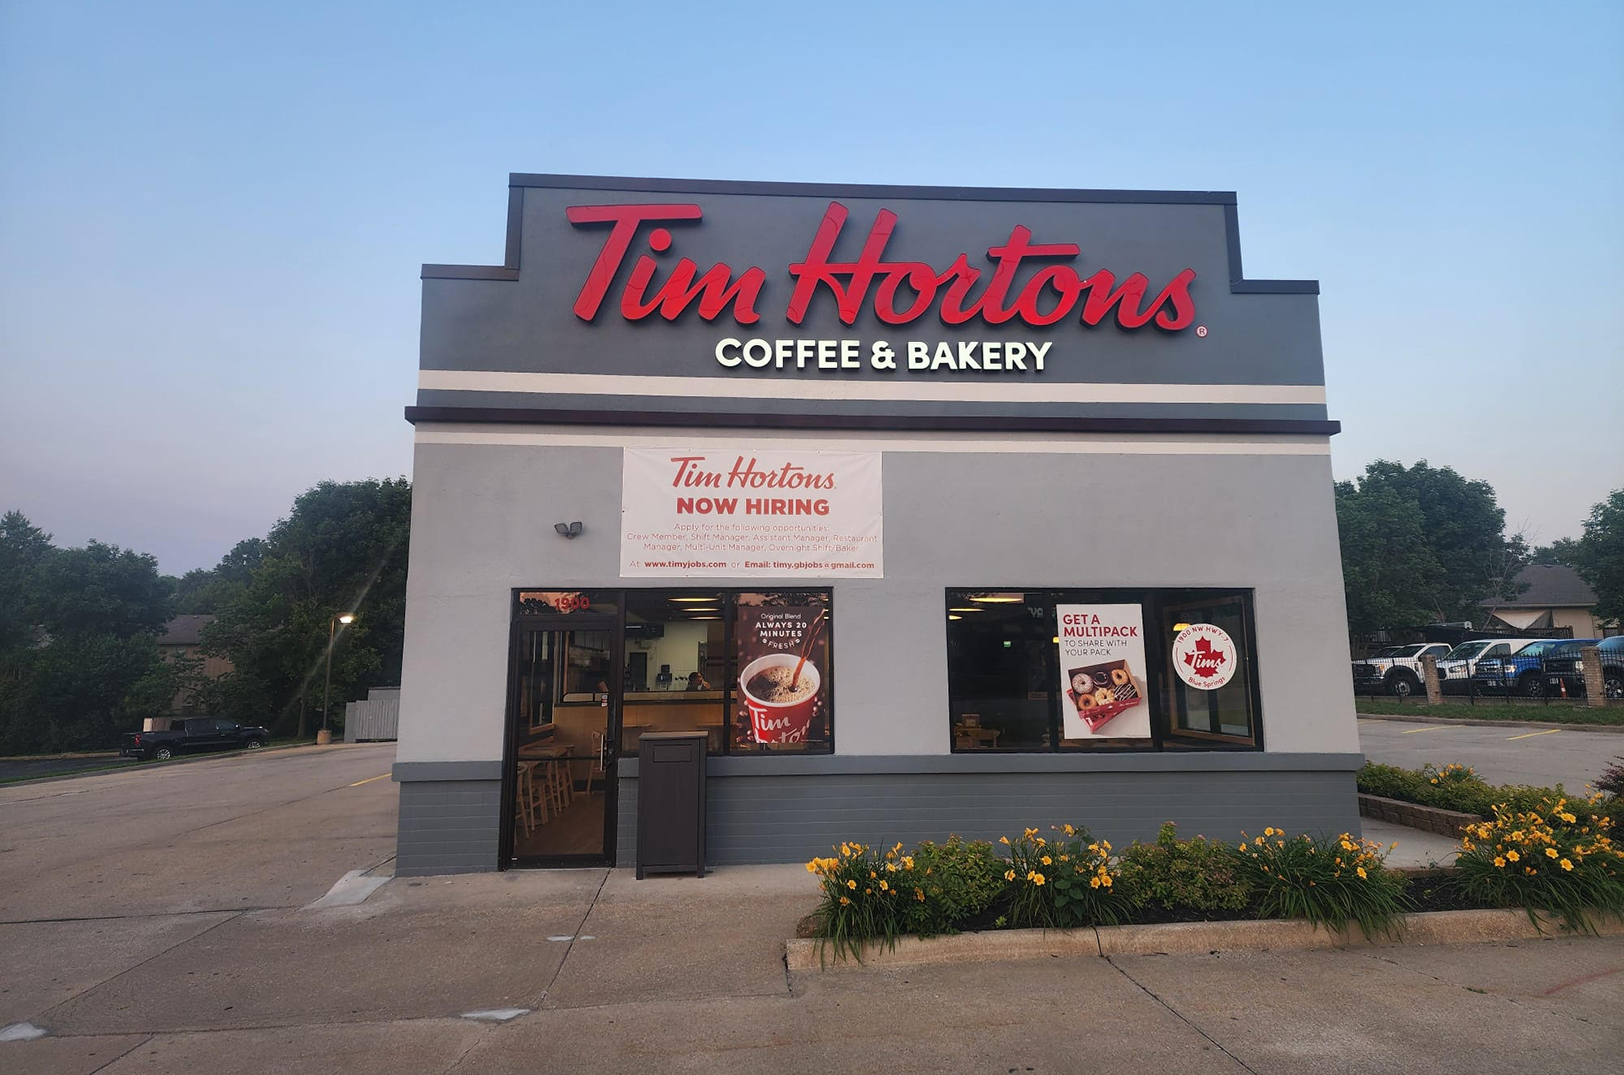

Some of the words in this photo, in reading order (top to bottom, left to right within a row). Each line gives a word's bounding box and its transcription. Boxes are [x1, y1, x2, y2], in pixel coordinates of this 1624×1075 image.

[566, 203, 767, 324] Tim
[788, 201, 1197, 331] Hortons
[714, 338, 861, 371] COFFEE
[870, 340, 896, 371] &
[907, 340, 1053, 372] BAKERY
[671, 456, 721, 488] Tim
[727, 455, 835, 490] Hortons
[676, 497, 738, 514] NOW
[745, 499, 830, 516] HIRING
[673, 523, 699, 532] Apply
[702, 523, 713, 531] for
[732, 523, 770, 533] following
[627, 533, 649, 541] Crew
[690, 533, 710, 541] Shift
[753, 534, 791, 542] Assistant
[833, 535, 878, 543] Restaurant
[684, 543, 726, 551] Multi-Unit
[769, 544, 810, 553] Overnight
[644, 561, 727, 569] www.timyjobs.com
[555, 597, 590, 610] 1900
[760, 613, 784, 621] Original
[1063, 614, 1088, 625] GET
[1091, 614, 1101, 625] A
[755, 621, 793, 629] ALWAYS
[796, 621, 807, 629] 20
[760, 630, 802, 638] MINUTES
[1064, 626, 1138, 637] MULTIPACK
[1177, 629, 1191, 644] 1900
[767, 640, 795, 650] FRESH
[1189, 650, 1221, 669] Tims
[1188, 677, 1202, 686] Blue
[1203, 677, 1225, 688] Springs
[748, 705, 791, 731] Tim
